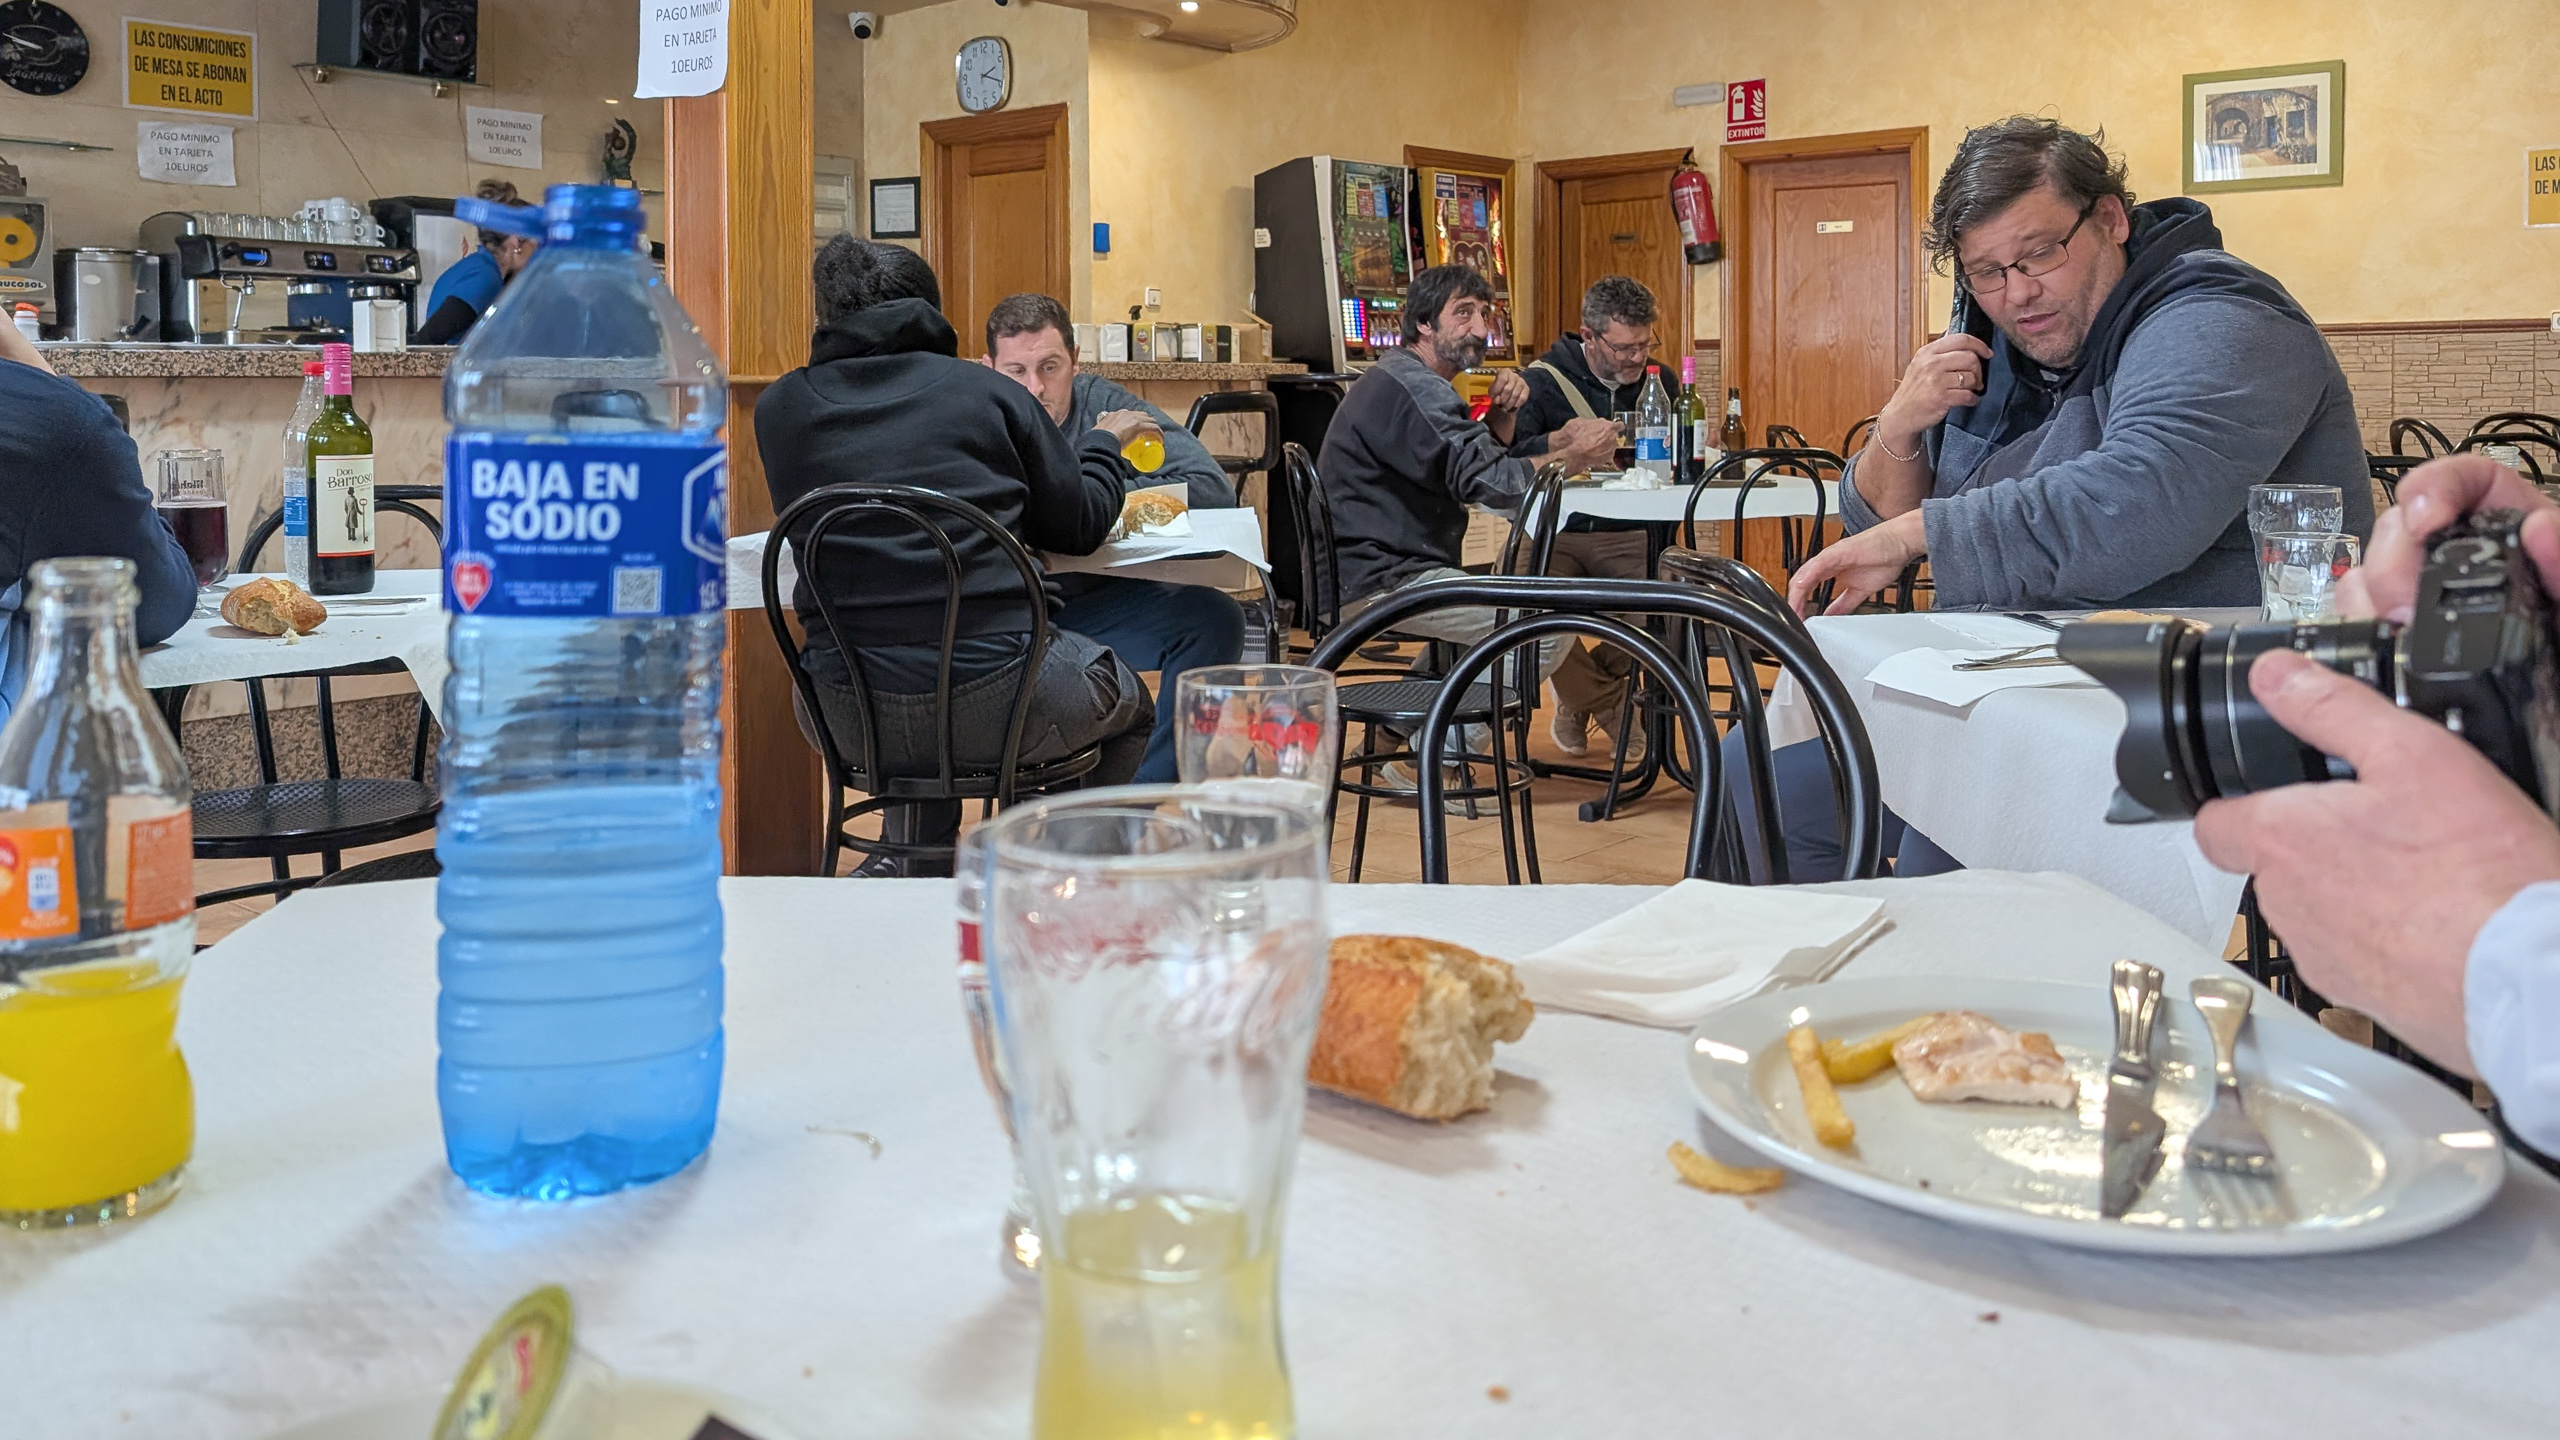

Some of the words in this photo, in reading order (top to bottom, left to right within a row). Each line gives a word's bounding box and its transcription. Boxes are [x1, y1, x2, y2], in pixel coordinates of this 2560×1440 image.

[656, 6, 688, 22] PAGO
[134, 29, 155, 47] LAS
[158, 32, 246, 58] CONSUMICIONES
[664, 34, 680, 48] EN
[683, 28, 717, 46] TARJETA
[134, 55, 149, 73] DE
[152, 57, 183, 76] MESA
[186, 61, 200, 79] SE
[203, 63, 247, 83] ABONAN
[671, 55, 713, 74] 10EUROS
[161, 84, 176, 101] EN
[179, 86, 192, 103] EL
[195, 88, 223, 106] ACTO
[477, 118, 498, 128] PAGO
[150, 131, 178, 141] PAGO
[483, 132, 494, 141] EN
[495, 133, 527, 144] TARJETA
[1728, 127, 1765, 138] EXTINTOR
[159, 146, 172, 156] EN
[174, 147, 214, 158] TARJETA
[489, 146, 523, 156] 10EUROS
[166, 162, 209, 173] 10EUROS
[2535, 156, 2556, 171] LAS
[2535, 180, 2549, 195] DE
[336, 468, 354, 477] Don
[327, 473, 373, 489] Barroso
[471, 458, 573, 506] BAJA
[583, 462, 640, 501] EN
[485, 501, 623, 542] SODIO
